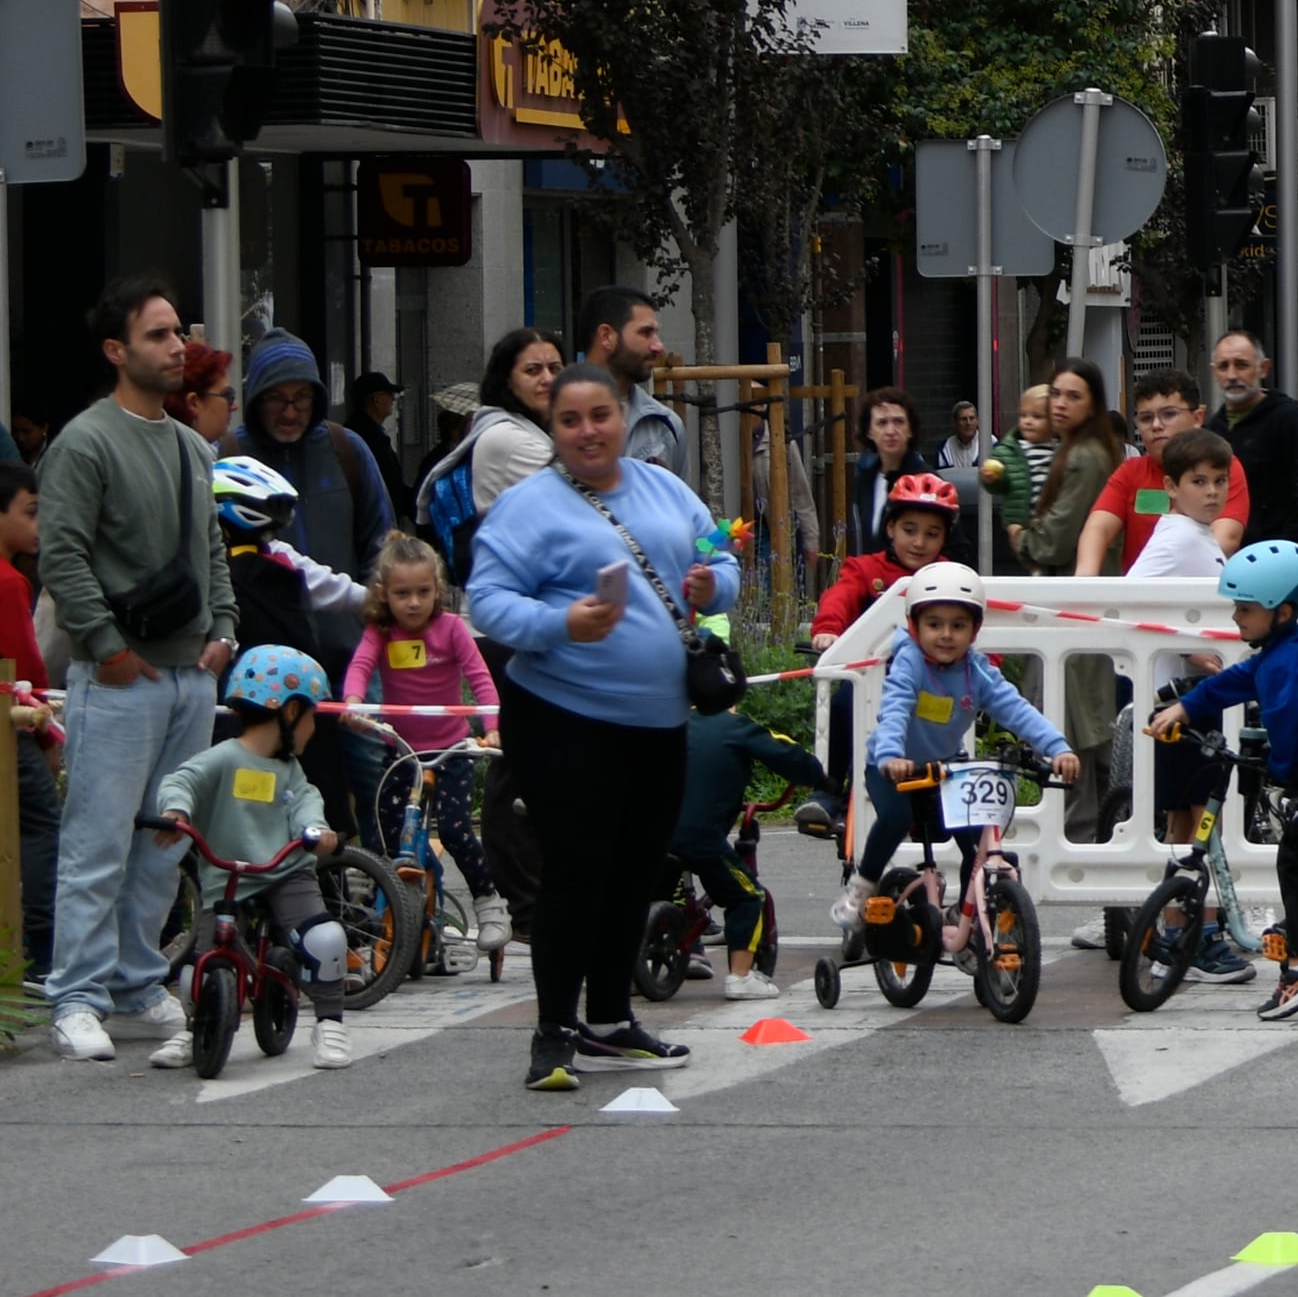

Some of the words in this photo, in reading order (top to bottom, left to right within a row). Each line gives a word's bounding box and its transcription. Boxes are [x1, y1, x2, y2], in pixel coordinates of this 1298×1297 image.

[362, 237, 460, 253] TABACOS
[615, 524, 647, 564] BIMBA
[651, 576, 676, 612] LOLA
[411, 644, 421, 660] 7
[960, 781, 1007, 805] 329
